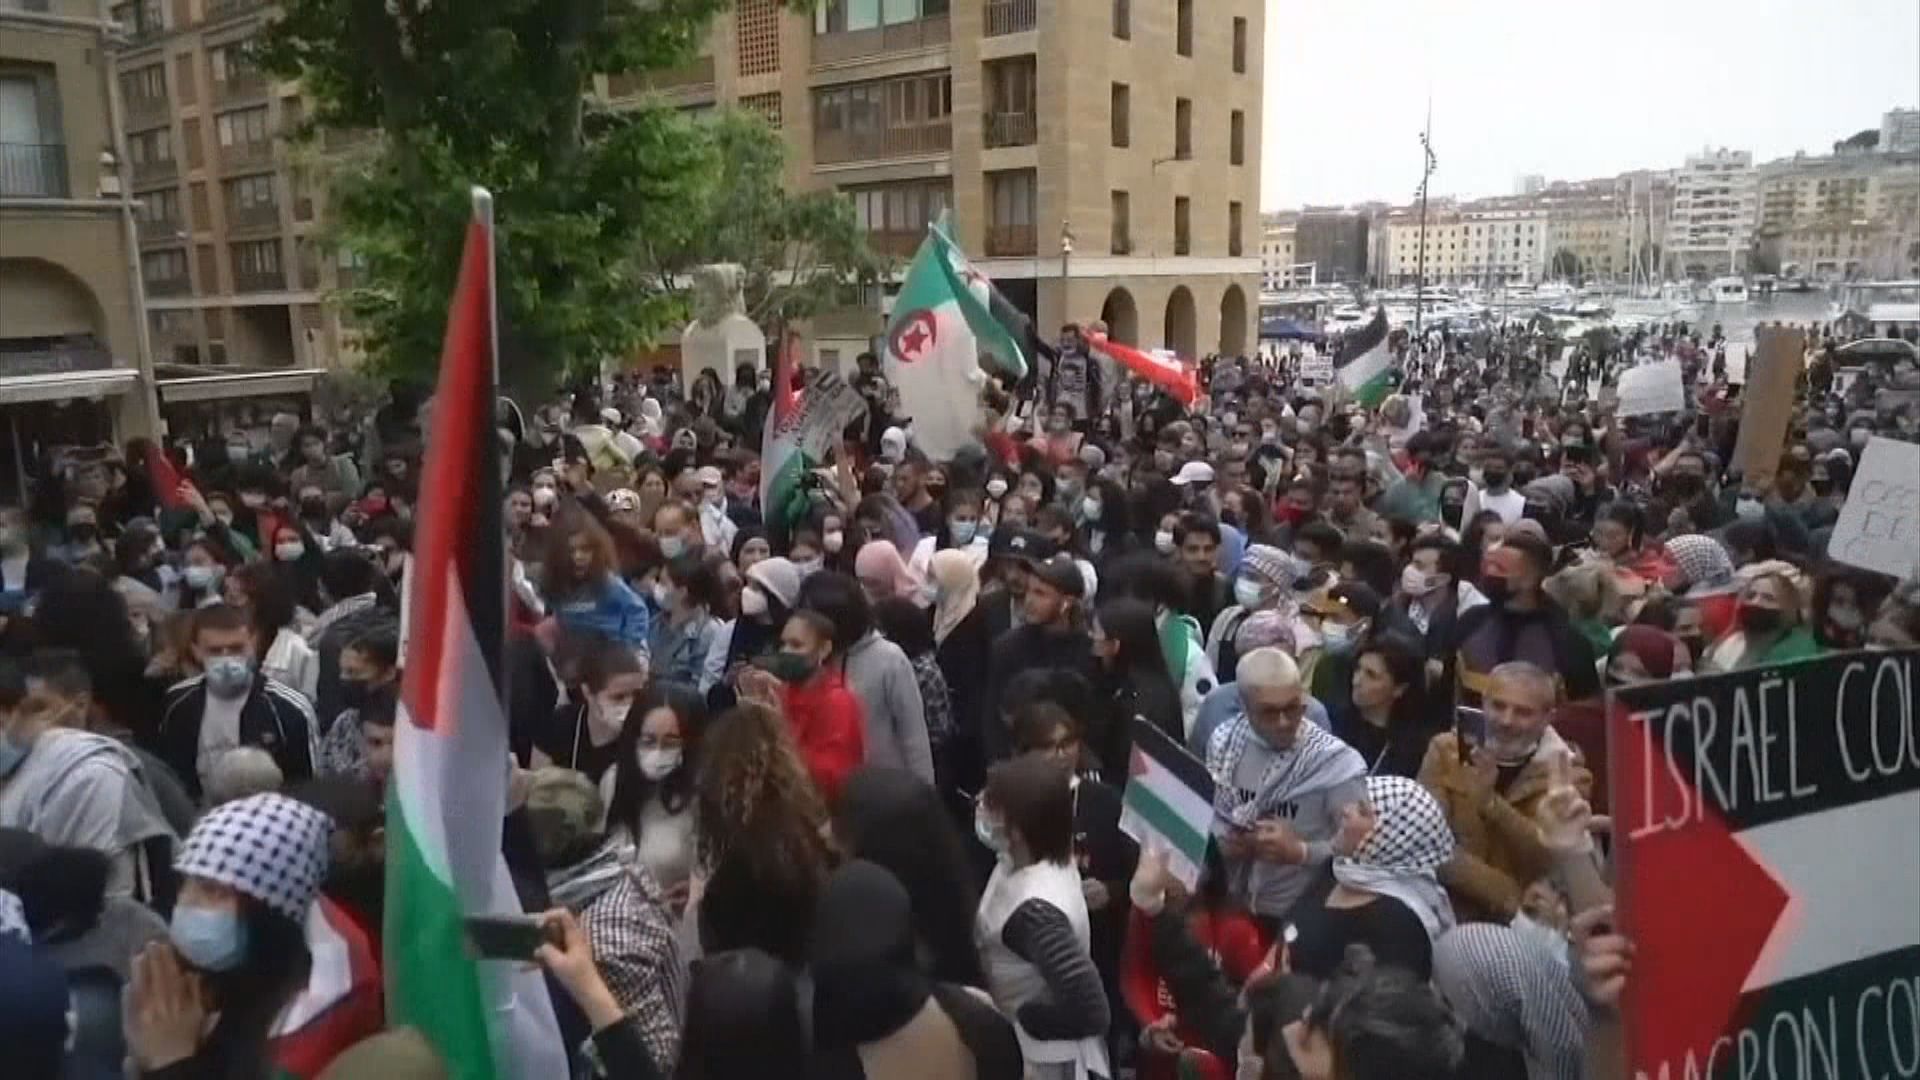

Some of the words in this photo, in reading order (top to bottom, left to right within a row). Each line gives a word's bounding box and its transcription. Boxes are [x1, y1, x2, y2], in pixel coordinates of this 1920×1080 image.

[1628, 670, 1818, 840] ISRAËL
[1634, 996, 1839, 1080] RON
[1856, 976, 1920, 1079] CO
